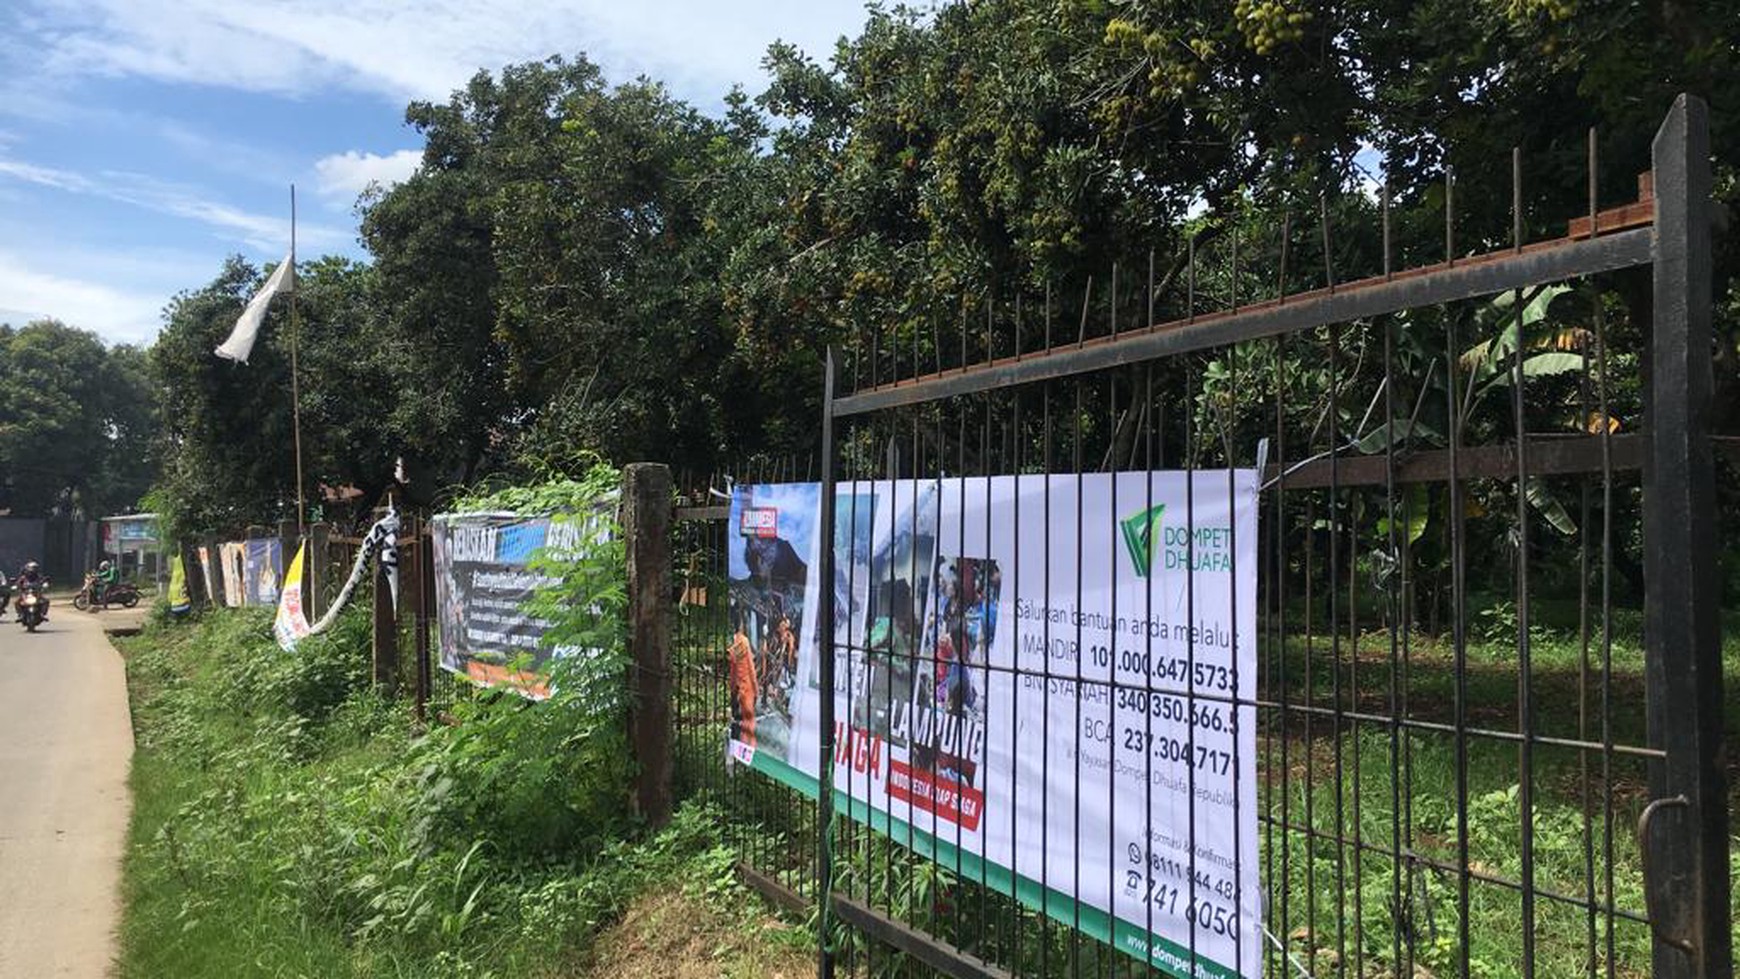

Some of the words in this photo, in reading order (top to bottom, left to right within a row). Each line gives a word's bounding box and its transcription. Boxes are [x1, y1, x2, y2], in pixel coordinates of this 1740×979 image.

[1164, 526, 1230, 549] DOMPET
[1164, 549, 1233, 572] DHUAFA
[1071, 603, 1127, 633] bantun
[1131, 613, 1168, 640] anda
[1023, 634, 1081, 662] MANDIR
[1024, 669, 1047, 690] BN
[1085, 717, 1115, 745] BCA
[834, 720, 882, 780] IAGA
[1114, 759, 1150, 783] Dompe
[890, 768, 931, 799] INDOESIA
[951, 791, 977, 817] SAGA
